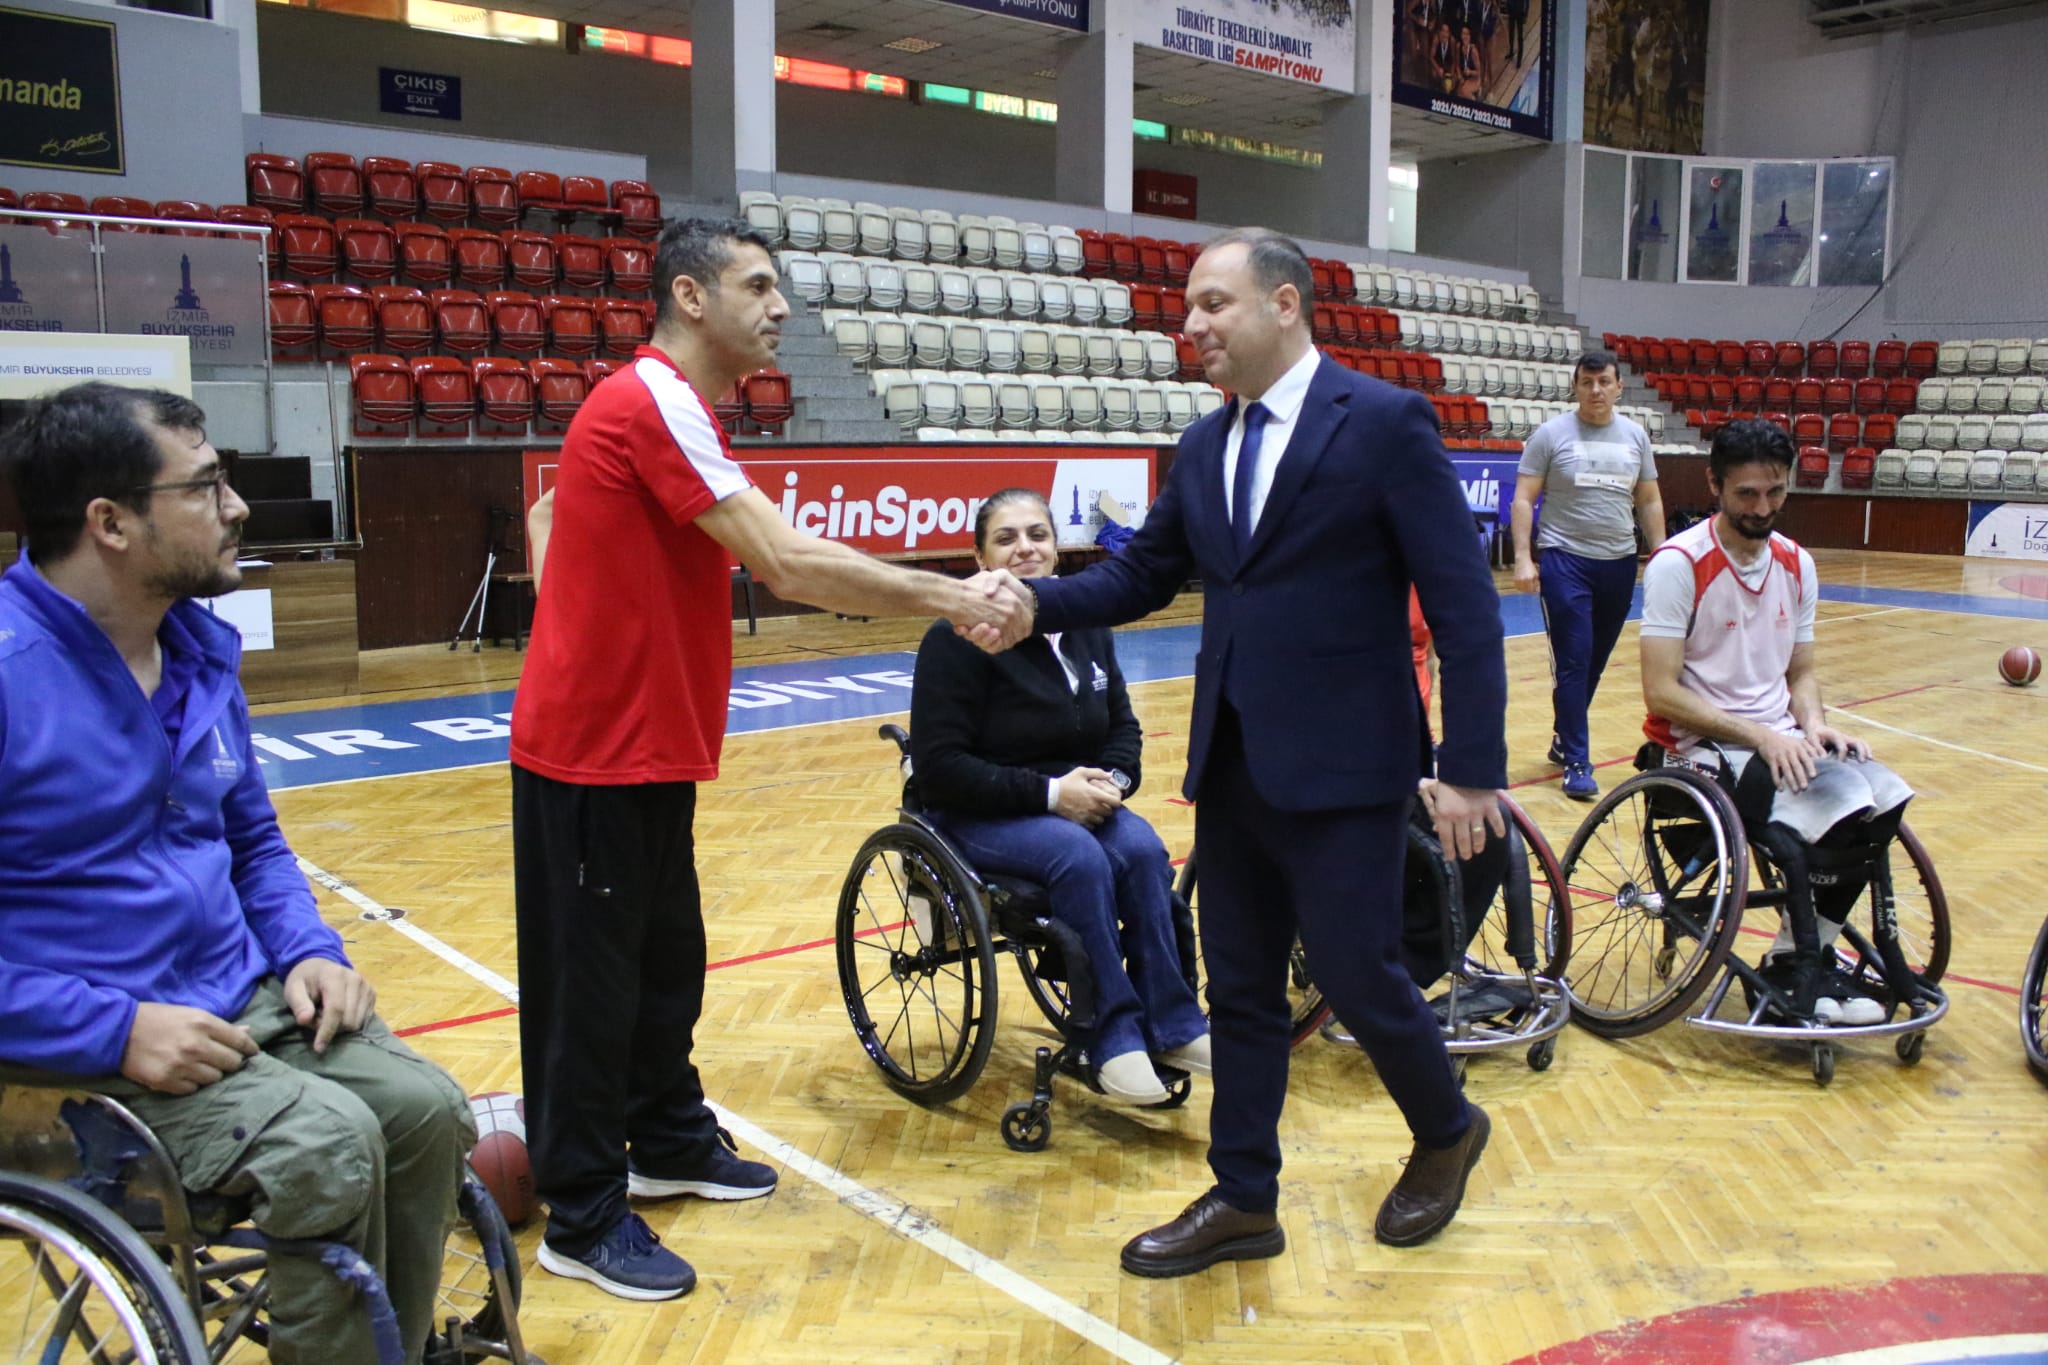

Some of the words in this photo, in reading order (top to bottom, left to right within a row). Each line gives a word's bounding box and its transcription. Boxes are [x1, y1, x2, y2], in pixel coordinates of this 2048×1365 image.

[1176, 5, 1215, 35] TÜRKİYE
[1217, 19, 1267, 48] TEKERLEKLİ
[1269, 31, 1313, 60] SANDALYE
[1162, 28, 1215, 58] BASKETBOL
[1217, 39, 1234, 63] LİGİ
[394, 74, 447, 94] ÇIKIŞ
[407, 94, 434, 105] EXIT
[1431, 98, 1512, 128] 2021/2022/2023/2024
[167, 310, 209, 322] İZMİR
[23, 363, 94, 376] BÜYÜKŞEHİR
[97, 364, 152, 376] BELEDİYESİ
